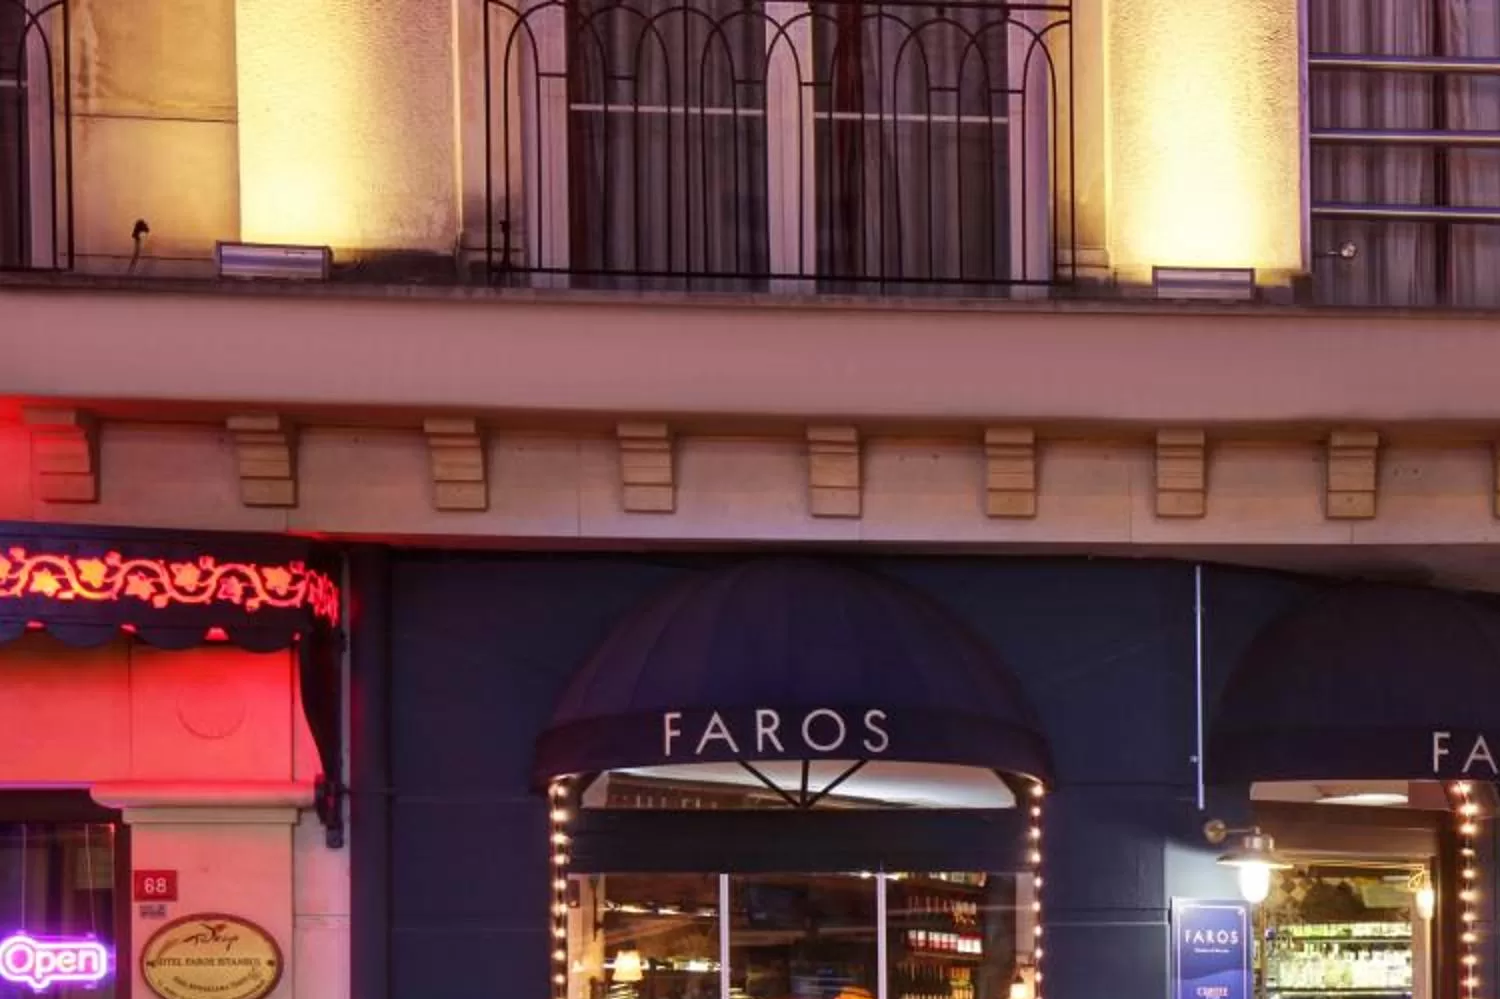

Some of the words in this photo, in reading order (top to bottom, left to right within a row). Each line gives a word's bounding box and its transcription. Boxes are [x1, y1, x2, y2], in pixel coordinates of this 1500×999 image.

[664, 708, 889, 756] FAROS
[144, 877, 167, 894] 68
[1184, 929, 1239, 945] FAROS
[5, 943, 98, 979] Open
